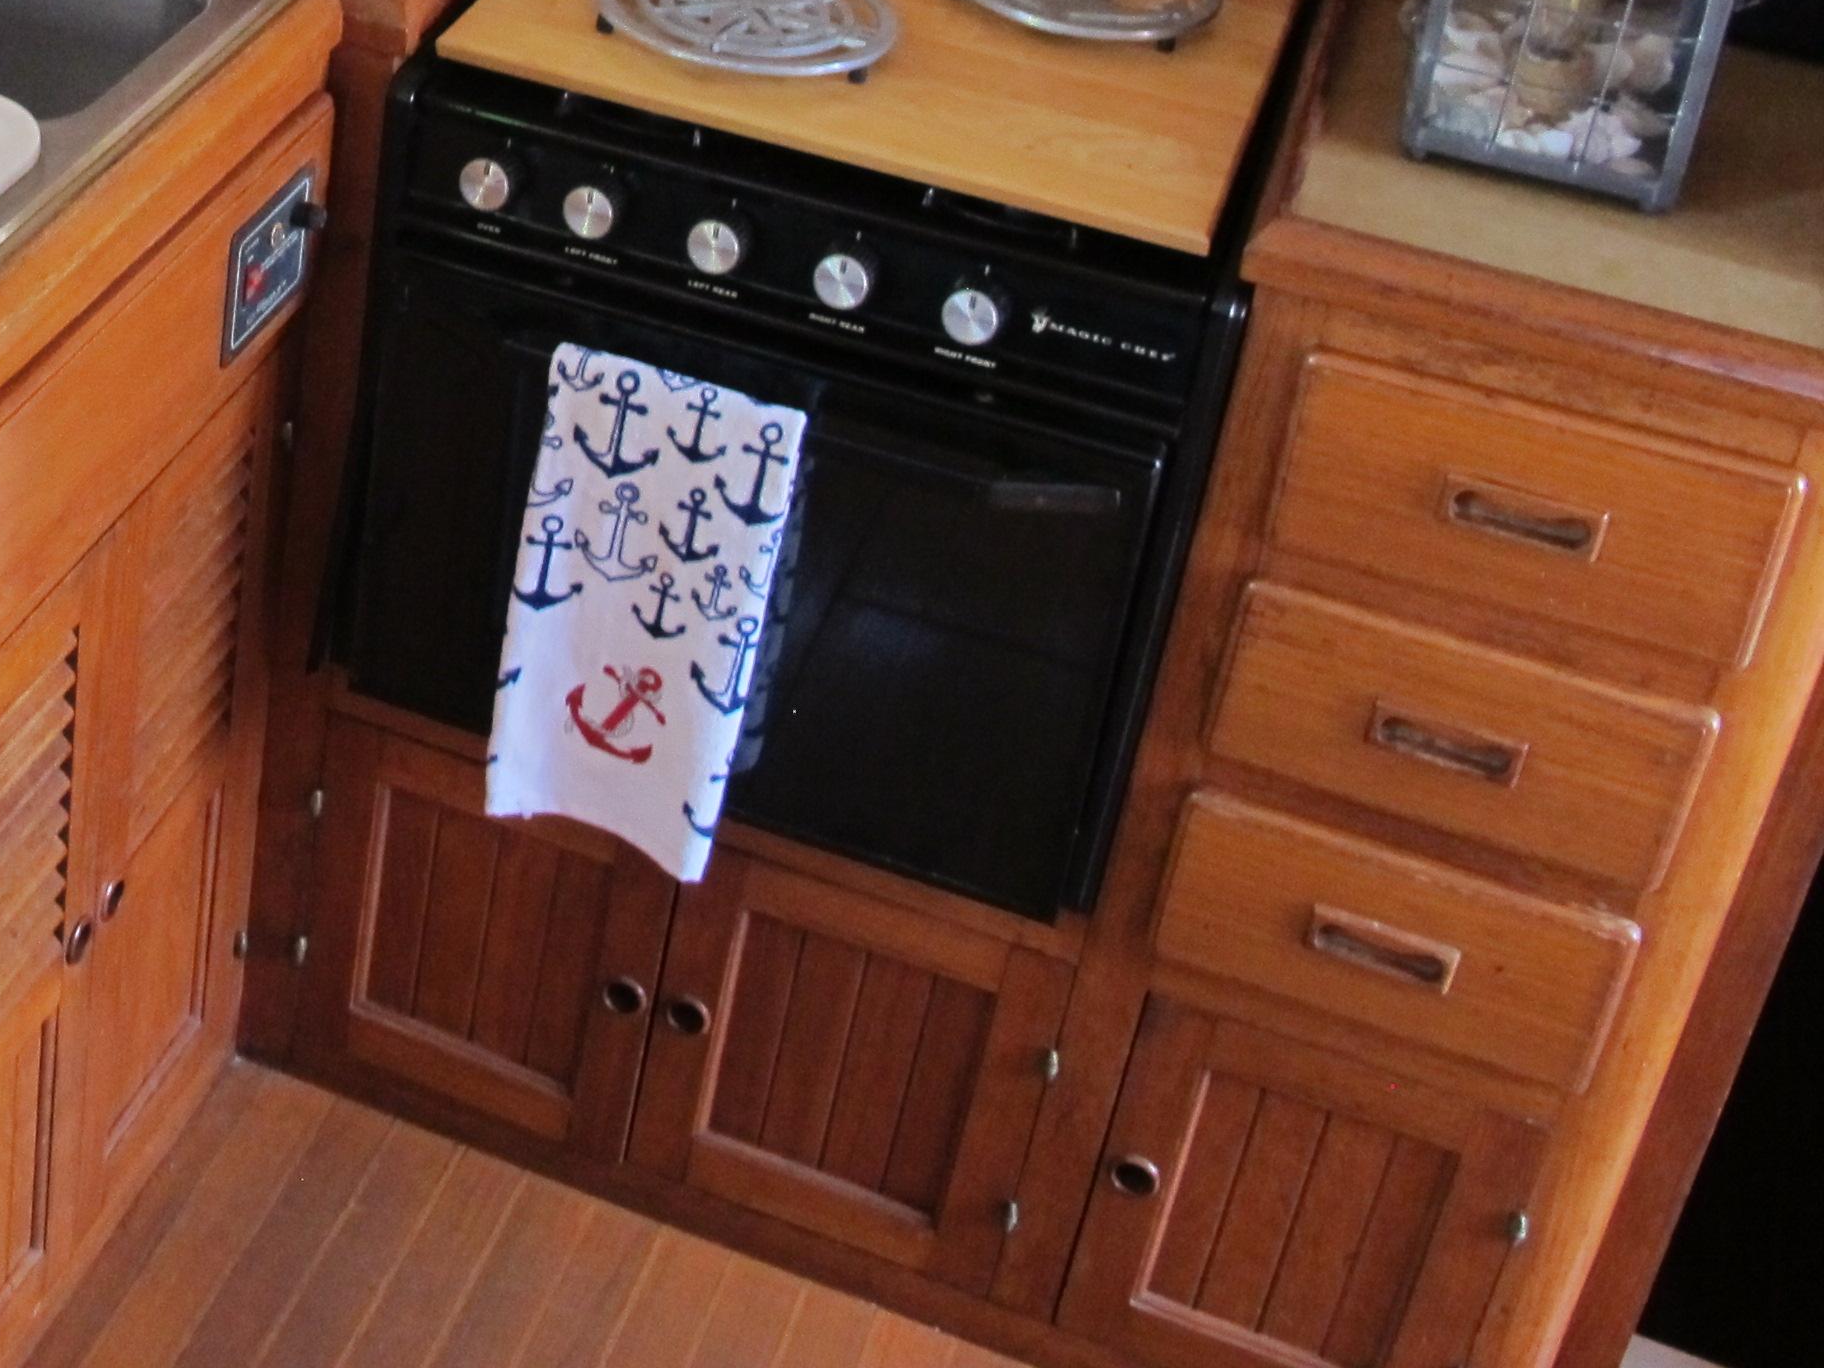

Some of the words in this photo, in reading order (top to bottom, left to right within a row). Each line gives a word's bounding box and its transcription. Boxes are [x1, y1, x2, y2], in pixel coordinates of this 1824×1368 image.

[687, 279, 710, 292] LEFT
[712, 286, 739, 299] REAR
[838, 320, 866, 334] REAR
[1048, 321, 1112, 346] MAGIC
[1120, 341, 1176, 362] CHEF
